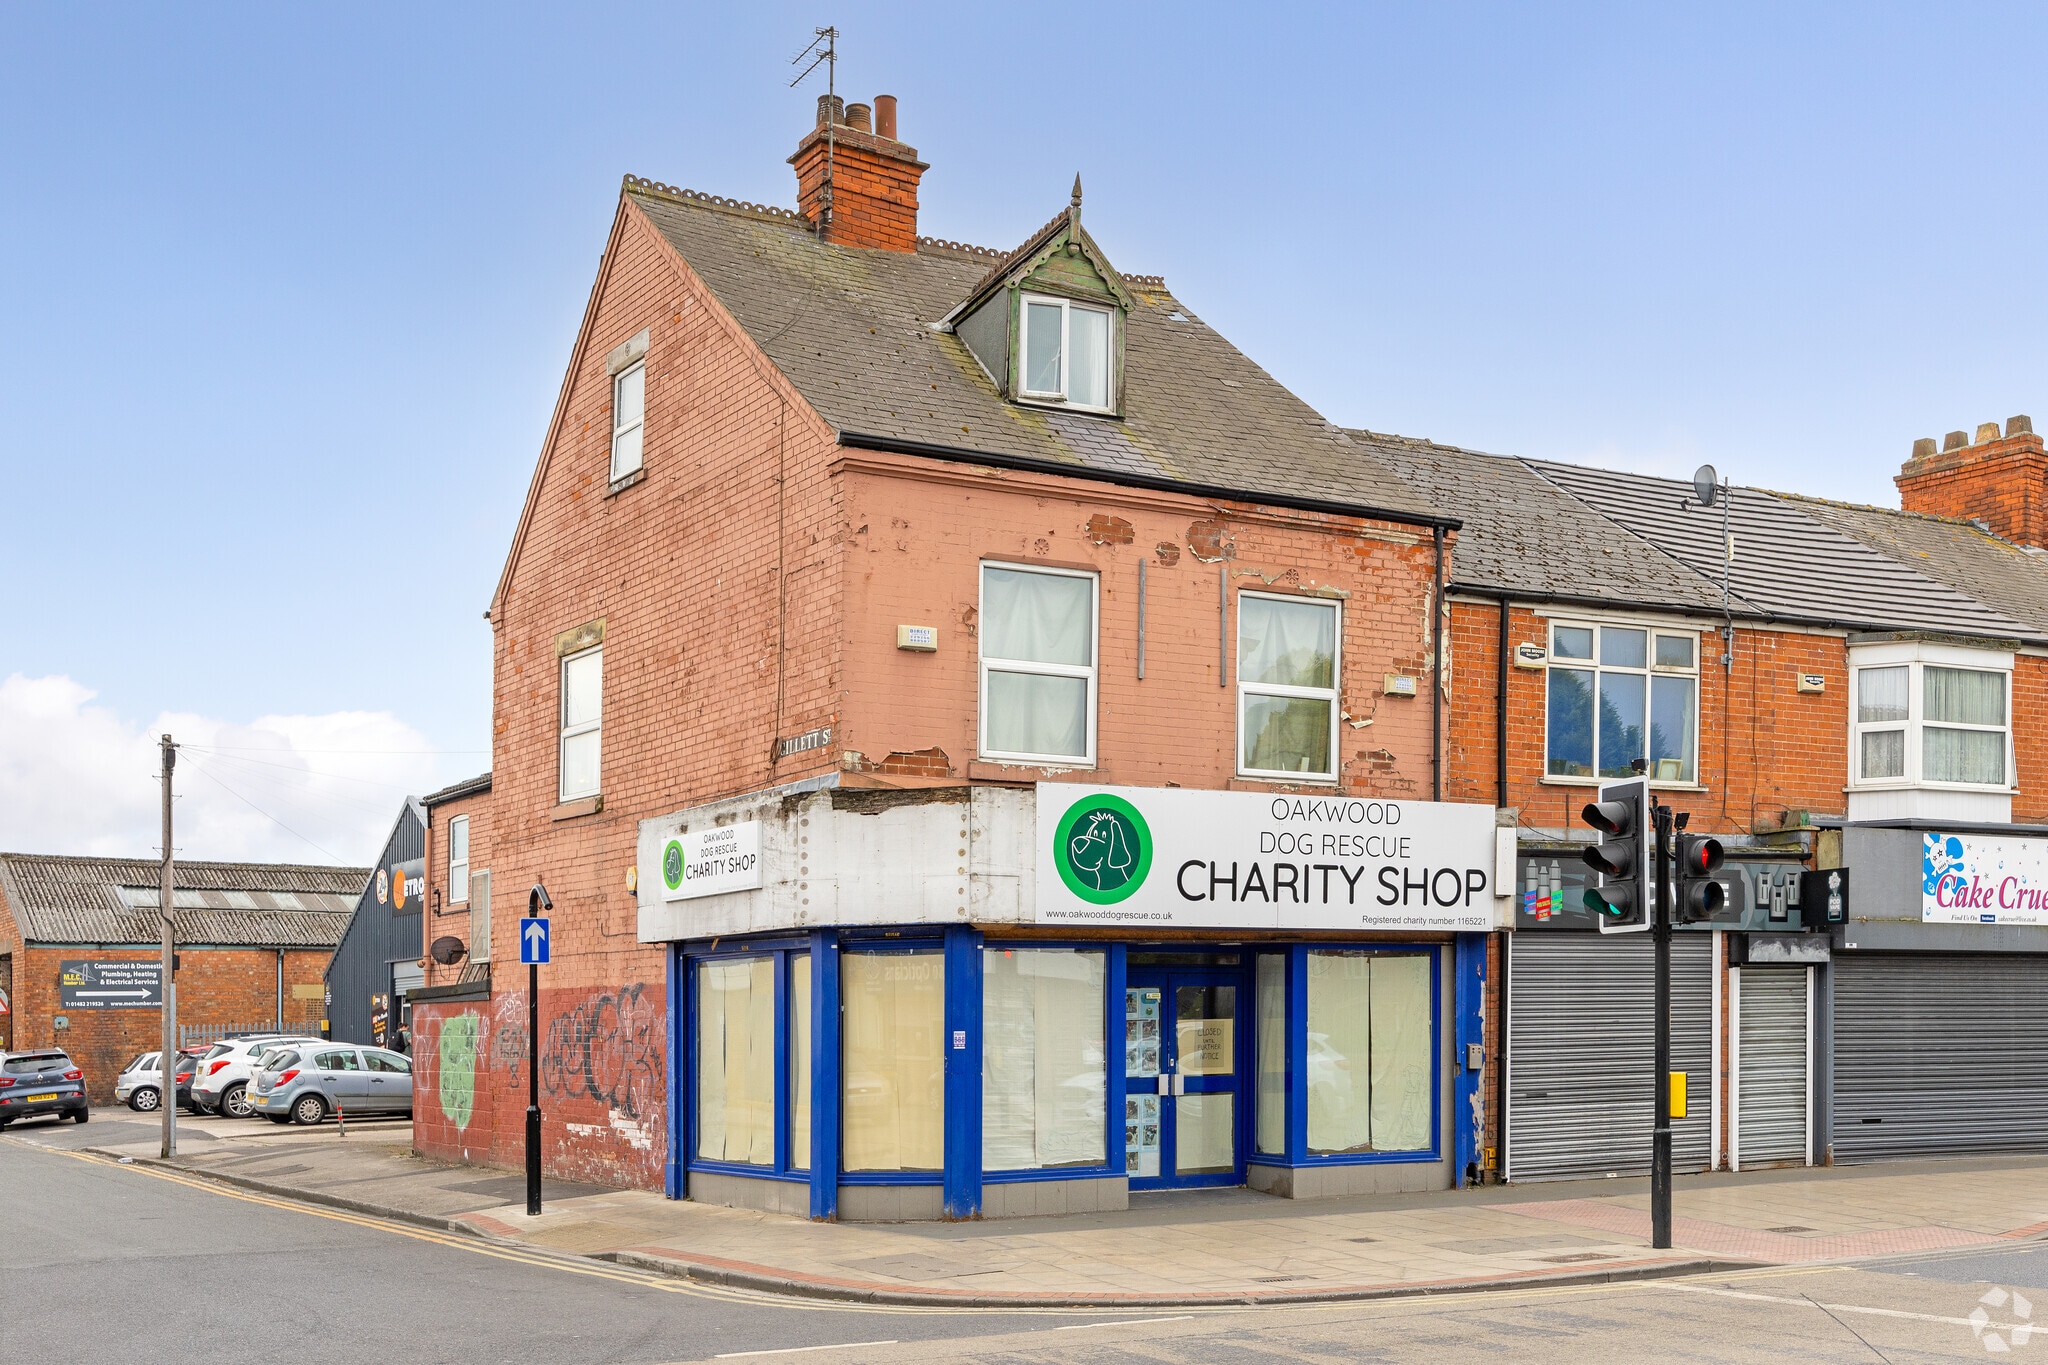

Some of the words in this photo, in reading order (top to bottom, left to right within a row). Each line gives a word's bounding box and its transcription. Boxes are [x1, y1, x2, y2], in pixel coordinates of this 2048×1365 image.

[1271, 798, 1401, 825] OAKWOOD
[703, 829, 735, 844] OAKWOOD
[700, 846, 714, 858] DOG
[714, 842, 737, 856] RESCUE
[1260, 831, 1313, 856] DOG
[1322, 834, 1411, 859] RESCUE
[685, 859, 726, 880] CHARITY
[728, 853, 756, 873] SHOP
[1176, 859, 1365, 905] CHARITY
[1376, 865, 1487, 907] SHOP
[1936, 873, 1994, 909] Cake
[1045, 910, 1173, 921] www.oakwooddogrescue.co.uk
[1362, 915, 1401, 925] Registered
[1403, 916, 1426, 926] charity
[1428, 917, 1455, 925] number
[1457, 917, 1486, 926] 1165221
[94, 962, 130, 970] Commercial
[101, 970, 133, 978] Plumbing,
[1197, 1027, 1222, 1037] CLOSED
[1197, 1043, 1222, 1051] FURTHER
[1200, 1051, 1220, 1060] NOTICE
